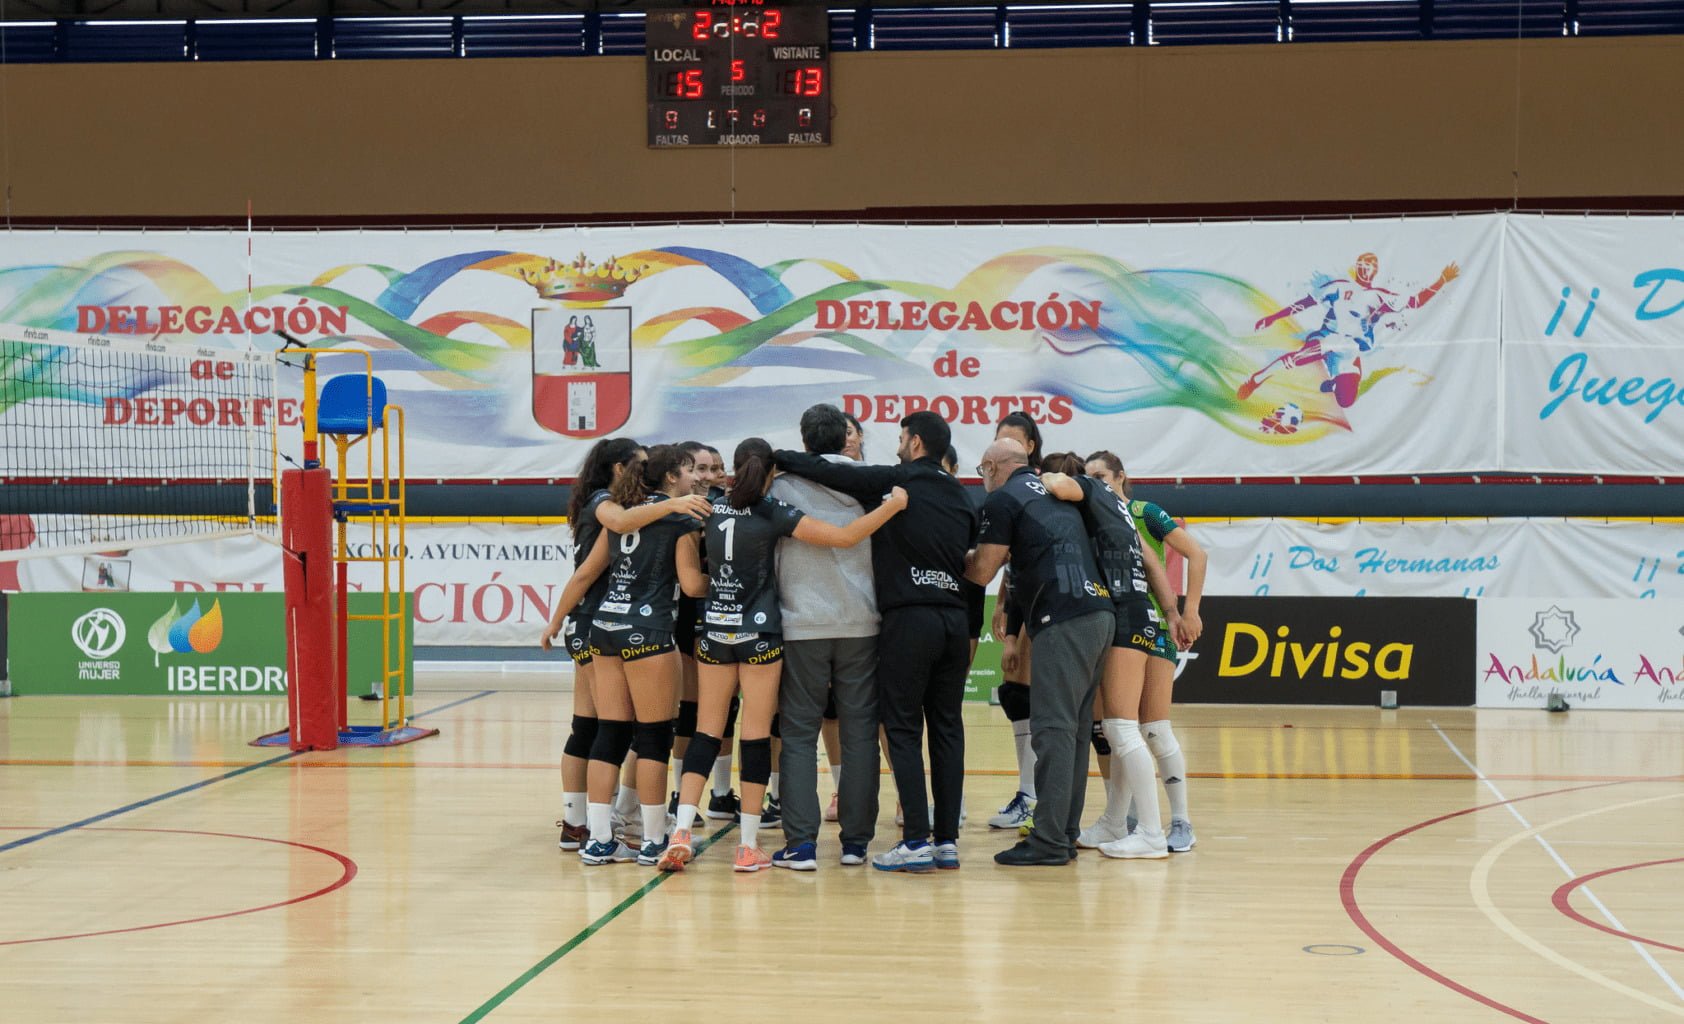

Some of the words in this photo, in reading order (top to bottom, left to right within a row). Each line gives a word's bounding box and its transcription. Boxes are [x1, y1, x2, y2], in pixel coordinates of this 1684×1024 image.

[654, 49, 701, 62] LOCAL
[773, 46, 821, 60] VISITANTE
[730, 59, 745, 81] 5
[675, 69, 704, 98] 15
[720, 84, 755, 97] PERIODO
[794, 67, 823, 97] 13
[656, 134, 690, 145] FALTAS
[718, 134, 760, 145] JUGADOR
[788, 133, 822, 145] FALTAS
[76, 298, 349, 335] DELEGACIÓN
[814, 292, 1102, 331] DELEGACIÓN
[933, 349, 981, 378] de
[1539, 352, 1684, 424] Jueg
[718, 517, 736, 561] 1
[420, 542, 574, 562] AYUNTAMIEN
[1289, 545, 1341, 573] Dos
[1354, 547, 1500, 574] Hermanas
[620, 643, 660, 660] Divisa
[748, 646, 781, 665] Divisa
[1217, 622, 1415, 681] Divisa
[78, 660, 121, 670] UNIVERSO
[78, 669, 121, 680] MUJER
[1483, 652, 1626, 687] Andalucía
[167, 665, 287, 692] IBERDR
